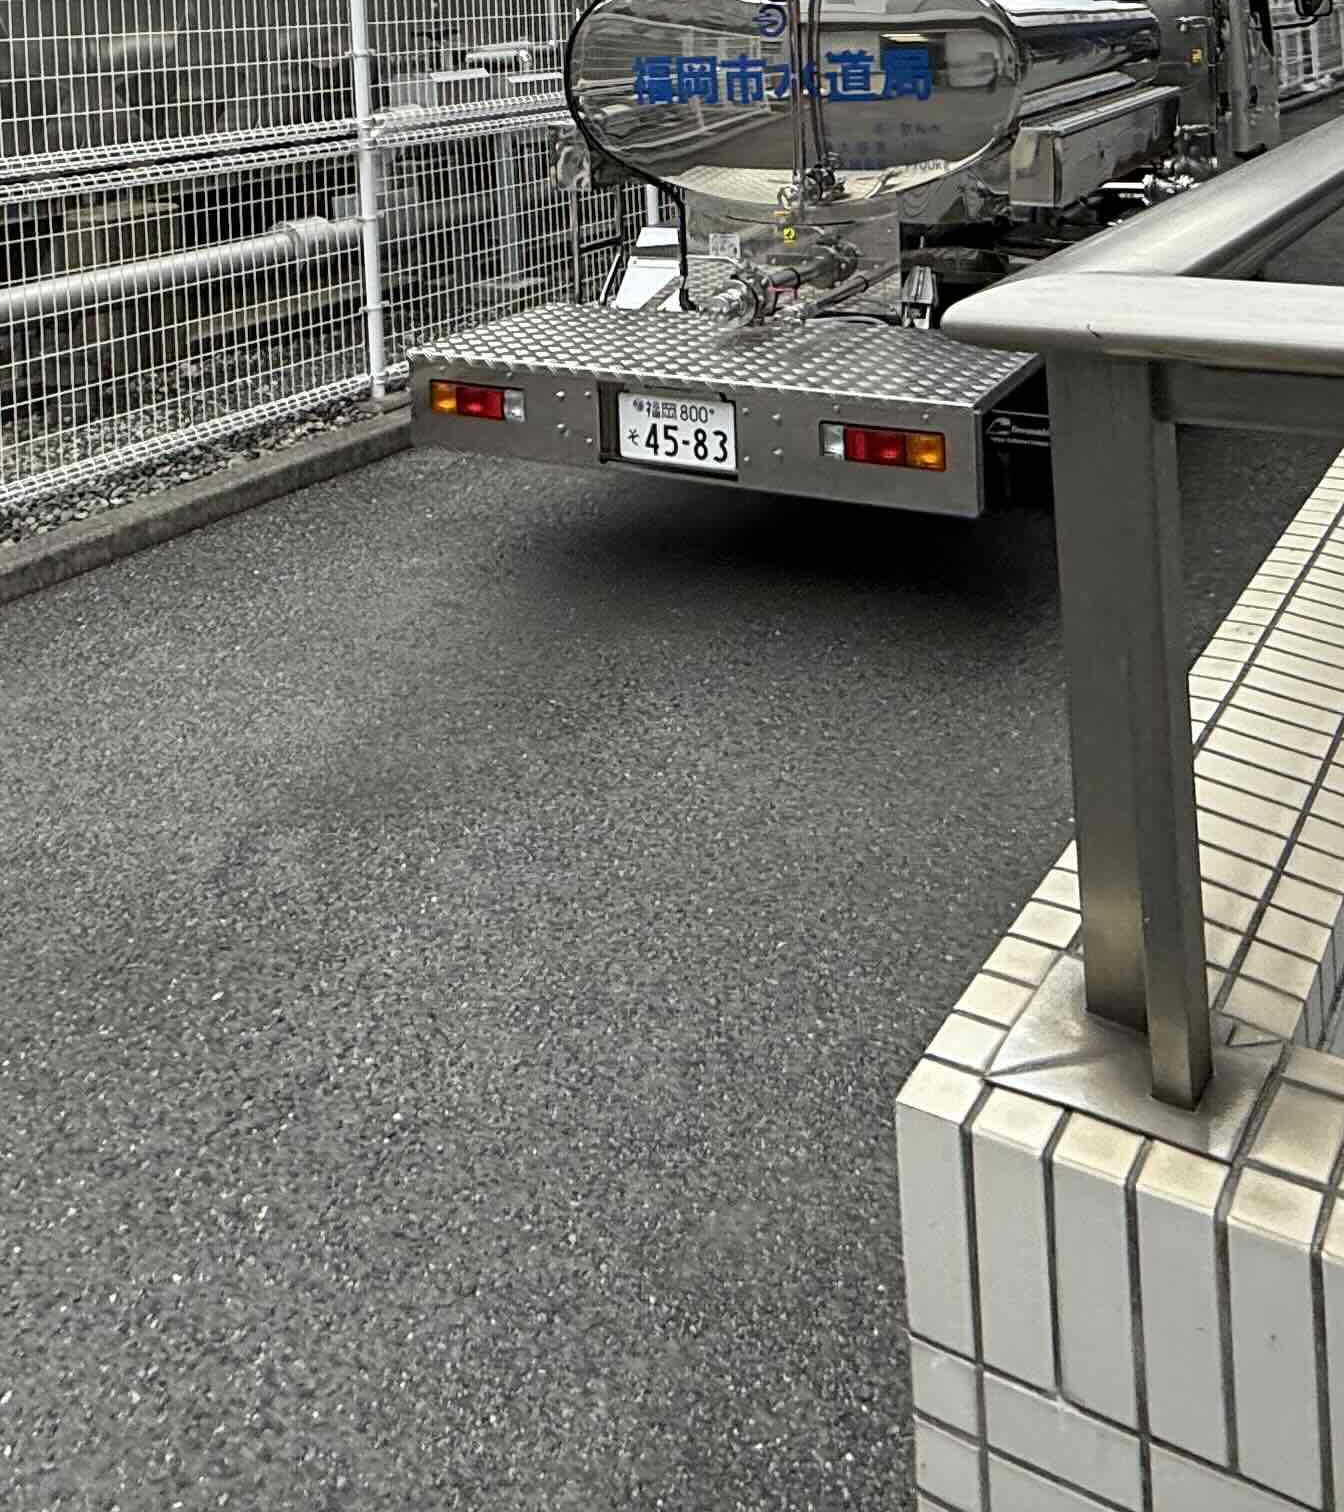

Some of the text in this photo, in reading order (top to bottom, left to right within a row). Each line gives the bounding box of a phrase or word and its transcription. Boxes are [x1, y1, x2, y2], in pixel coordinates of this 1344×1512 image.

[646, 400, 708, 424] 福岡 800
[645, 423, 728, 463] 45-83
